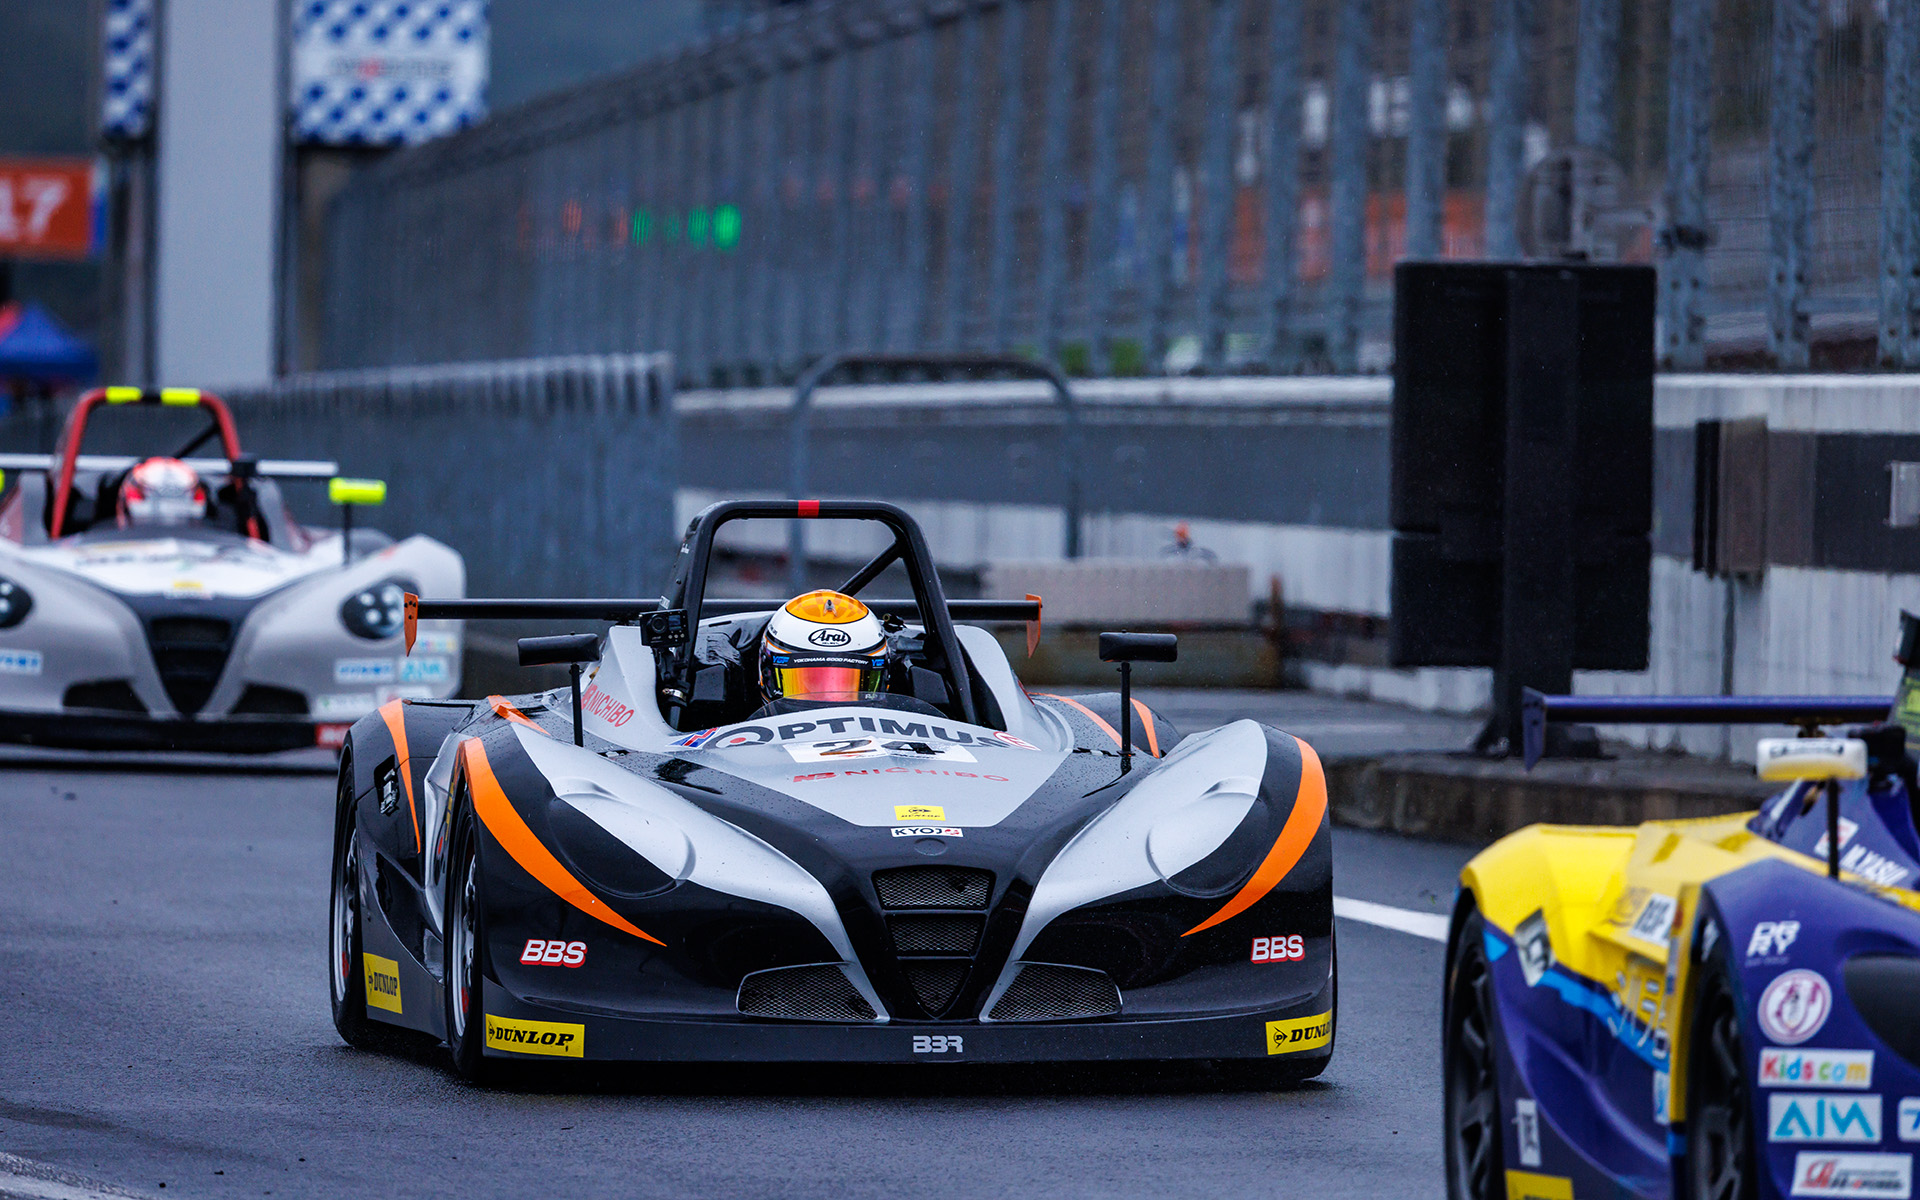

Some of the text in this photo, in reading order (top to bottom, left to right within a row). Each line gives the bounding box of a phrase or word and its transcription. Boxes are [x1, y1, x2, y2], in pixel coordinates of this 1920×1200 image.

[811, 630, 846, 642] Arai
[843, 657, 869, 665] FACTORY
[586, 690, 635, 728] NICHIBO
[702, 716, 1011, 750] OPTIMUS
[812, 739, 946, 756] 24
[844, 766, 1009, 782] NICHIBO
[520, 939, 588, 966] BBS
[1250, 934, 1305, 963] BBS
[373, 971, 398, 997] DUNLOP
[495, 1027, 574, 1046] DUNLOP
[1289, 1021, 1332, 1043] DUNLO
[1762, 1053, 1867, 1082] Kids com
[1774, 1099, 1875, 1138] AIM
